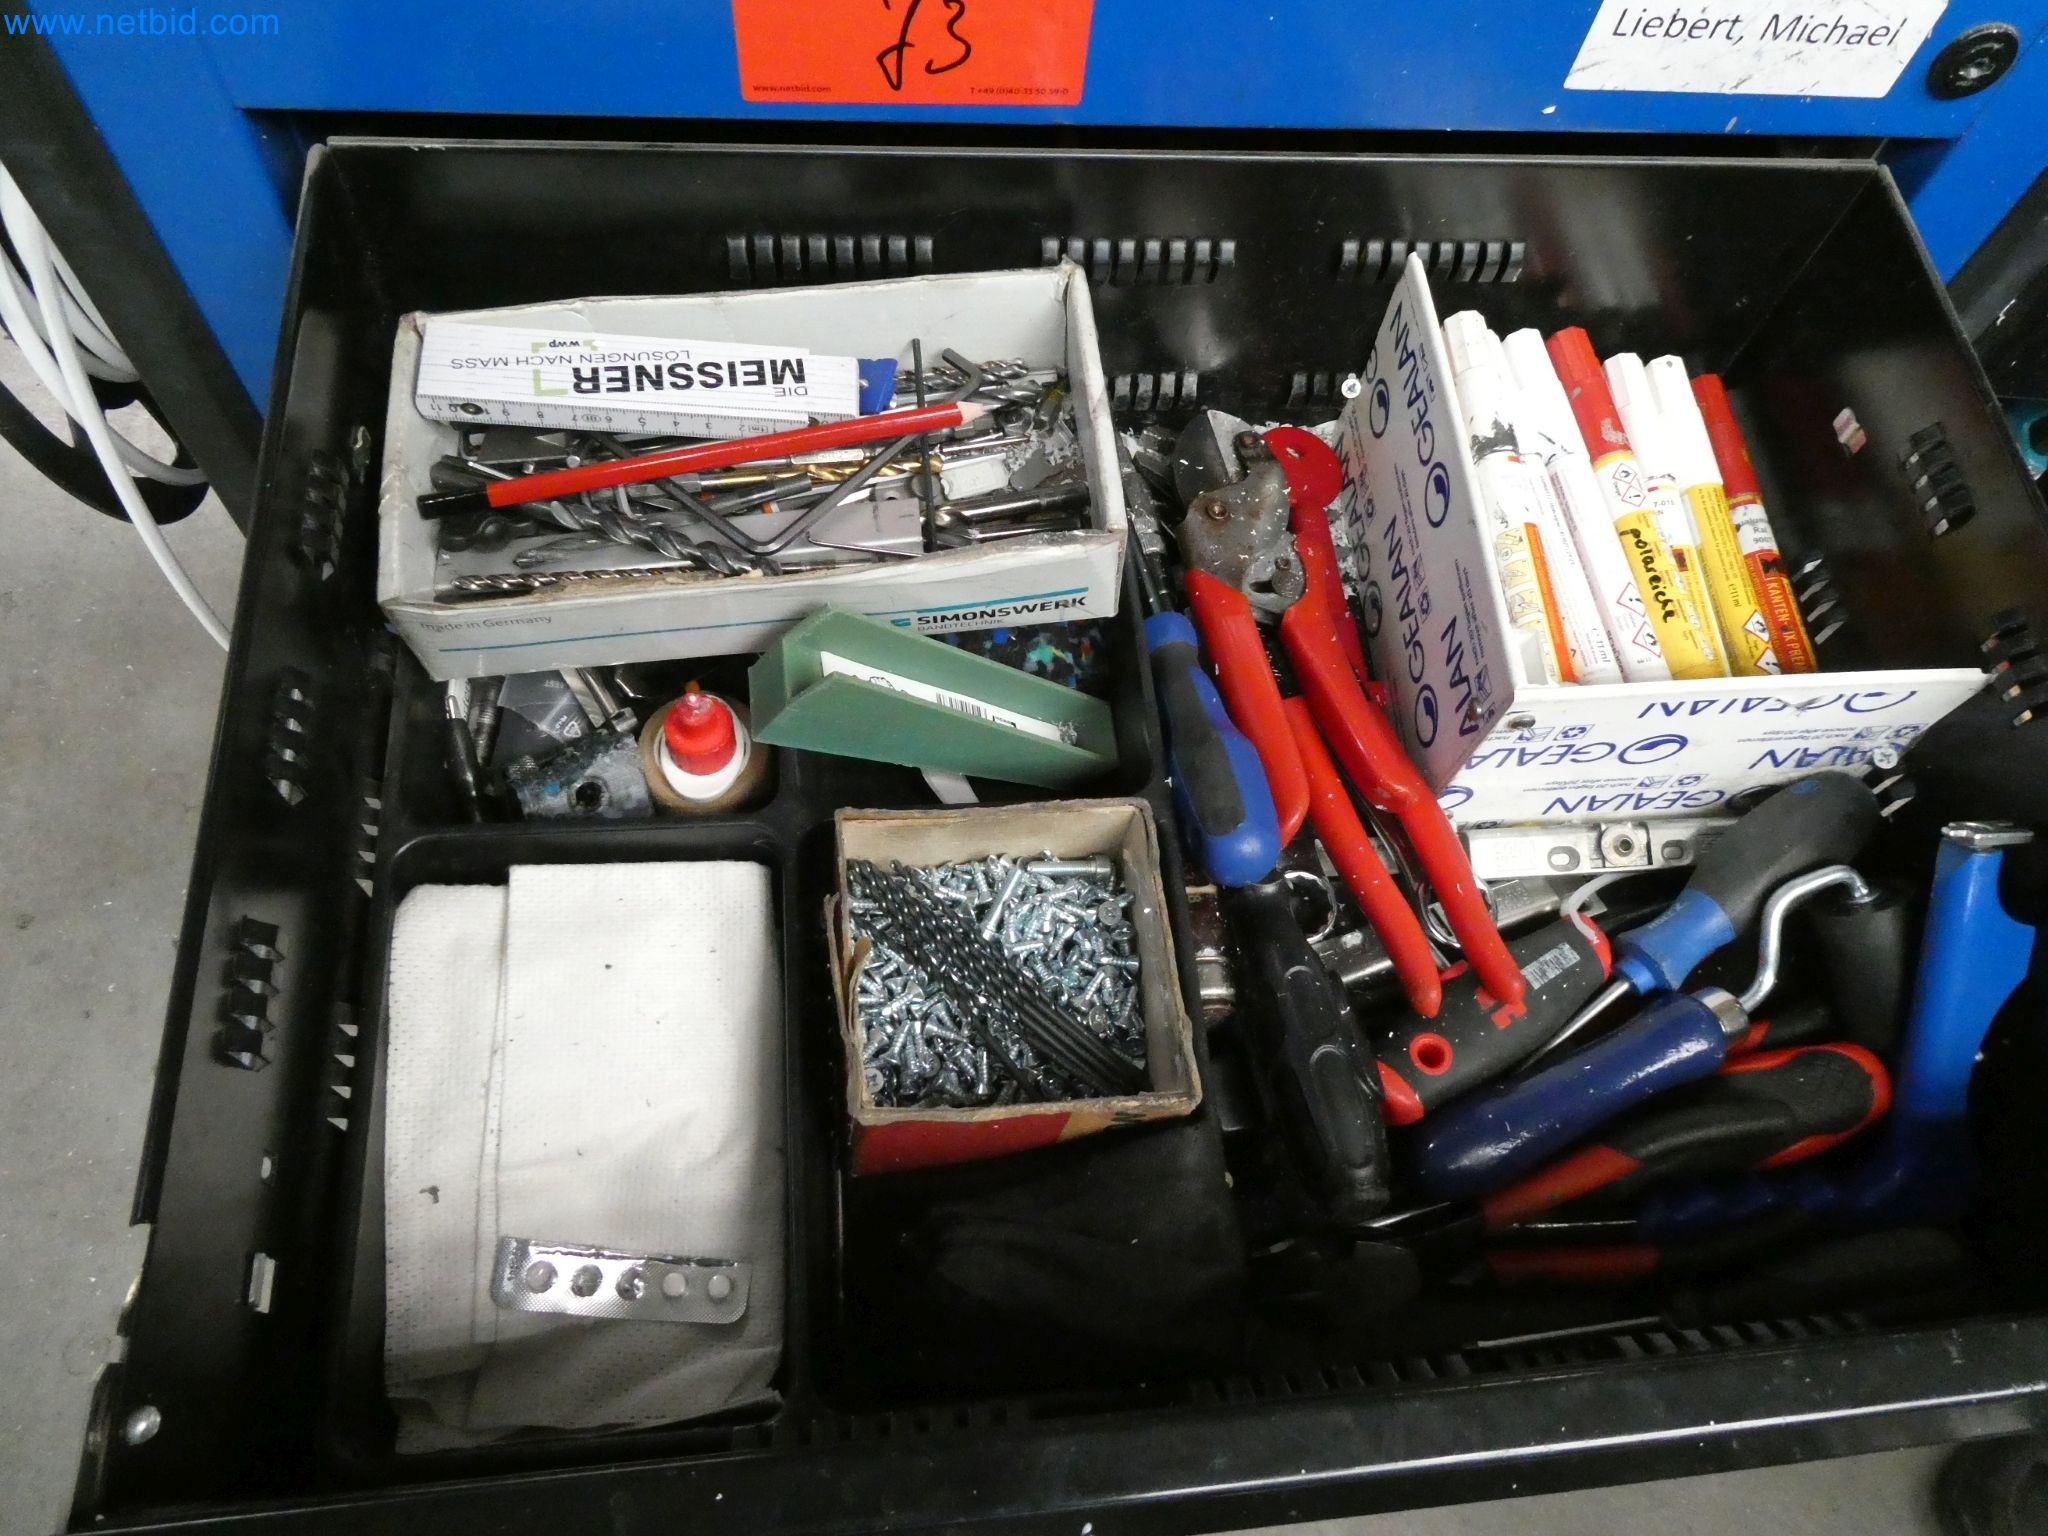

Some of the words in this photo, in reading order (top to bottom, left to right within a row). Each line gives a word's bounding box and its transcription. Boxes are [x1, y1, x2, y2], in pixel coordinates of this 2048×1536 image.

[1612, 7, 1746, 47] Liebert,
[1760, 14, 1908, 48] Michael
[549, 340, 580, 349] wwp
[450, 357, 510, 370] MASS
[516, 354, 572, 367] NACH
[579, 350, 691, 365] LÖSUNGEN
[572, 358, 806, 395] MEISSNER
[1390, 299, 1434, 467] GEALAN
[774, 386, 808, 397] DIE
[1383, 513, 1425, 684] GEALAN
[917, 596, 1087, 625] SIMONSWERK
[1765, 576, 1798, 643] KANTEN-IX
[466, 621, 481, 630] in
[482, 616, 552, 628] Germany
[917, 618, 1005, 632] BANDTECHNIK
[1541, 789, 1726, 816] GEALAN
